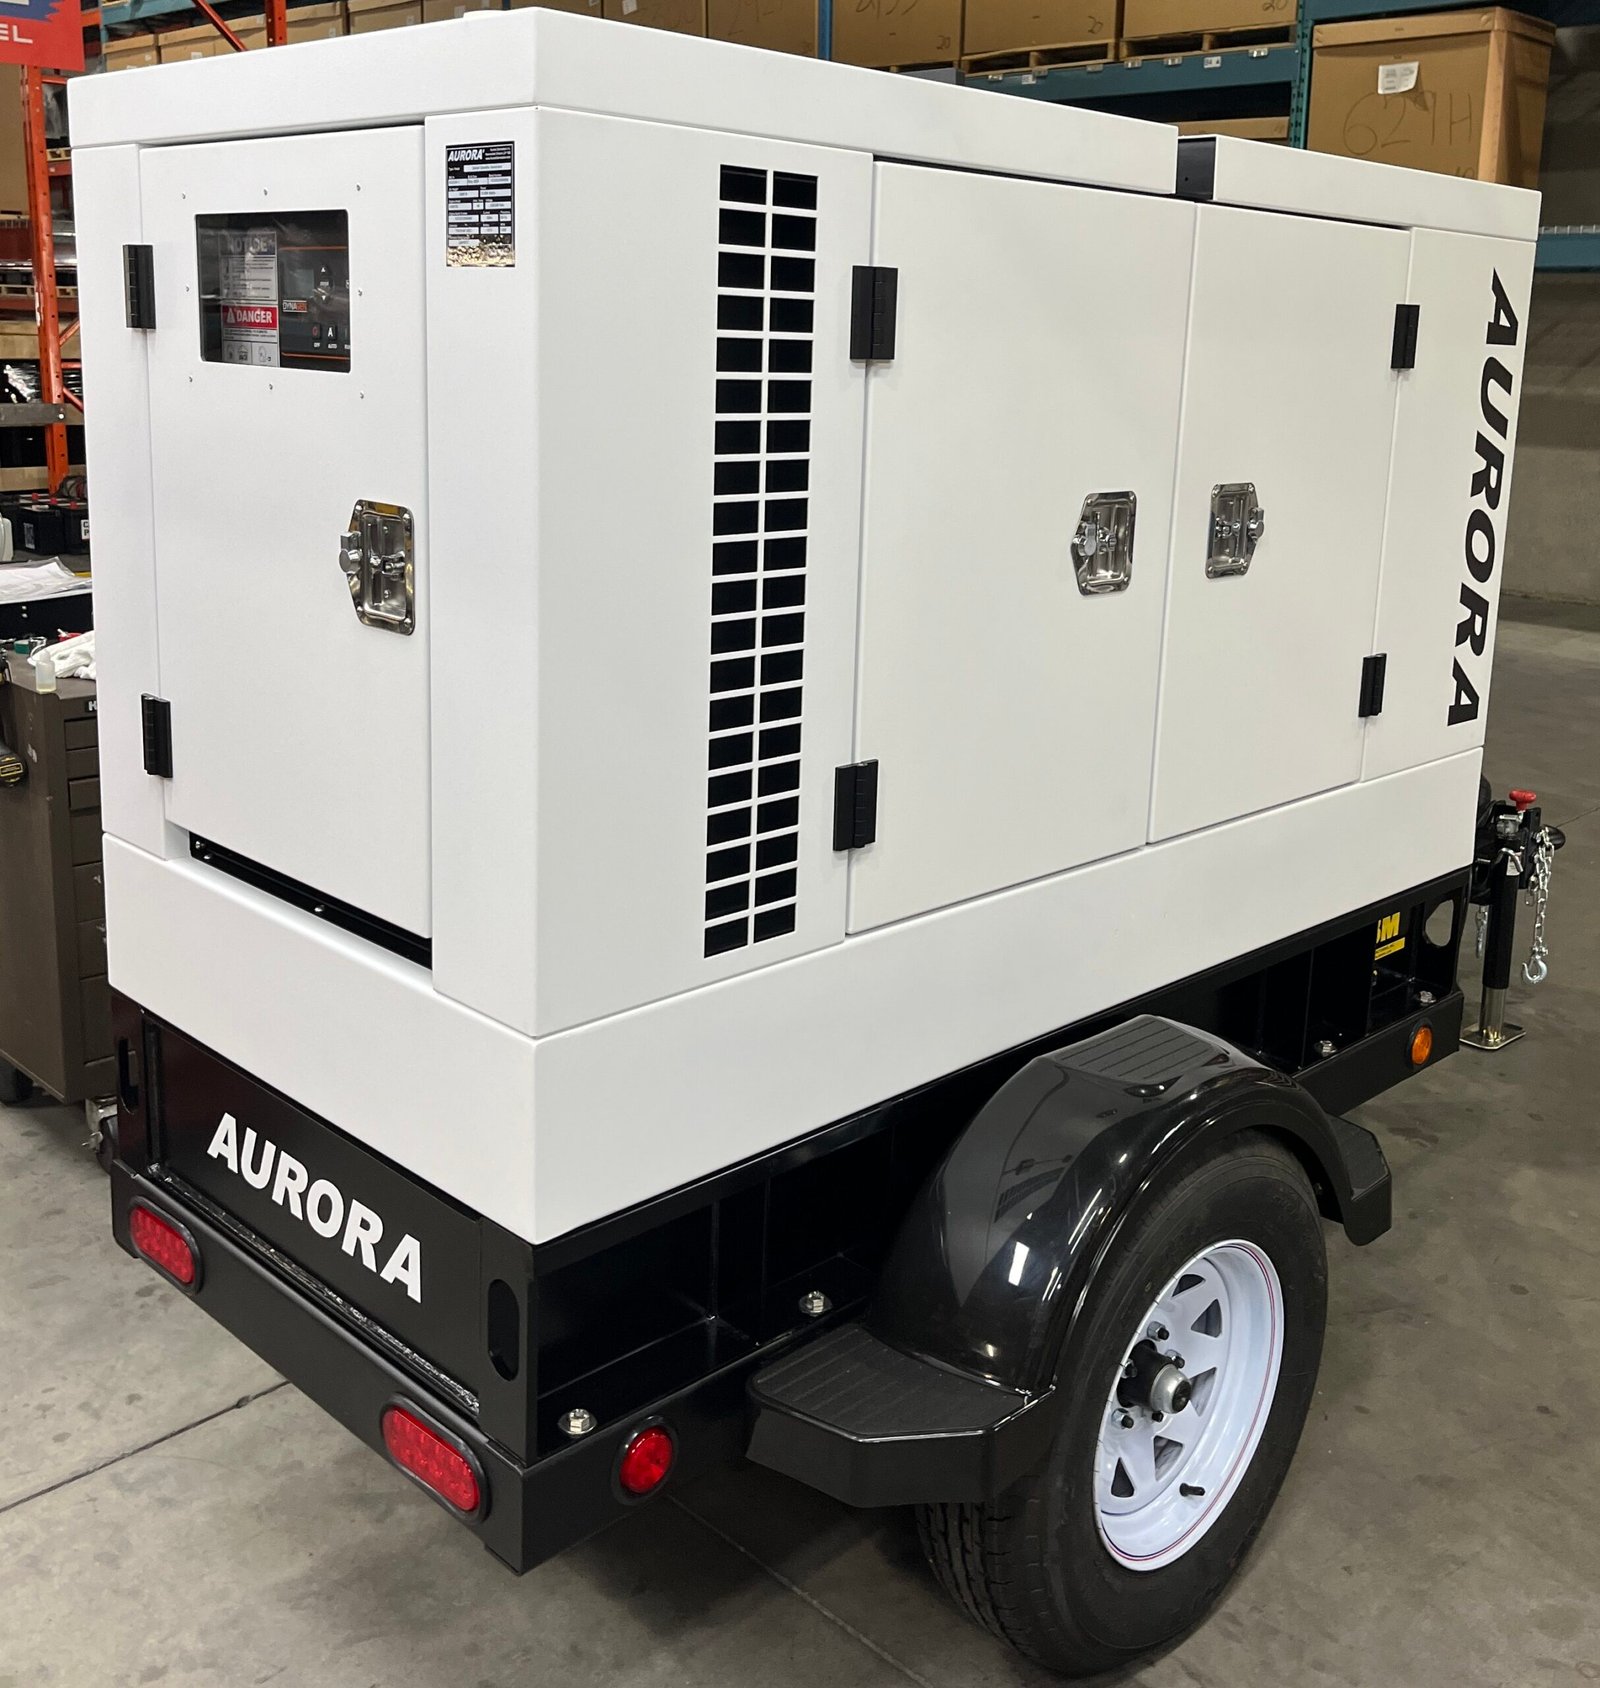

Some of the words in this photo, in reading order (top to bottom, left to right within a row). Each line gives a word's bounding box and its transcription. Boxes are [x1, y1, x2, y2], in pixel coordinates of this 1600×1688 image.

[448, 149, 483, 161] AURORA
[236, 309, 272, 323] DANGER
[1447, 267, 1519, 727] AURORA
[207, 1112, 421, 1304] AURORA
